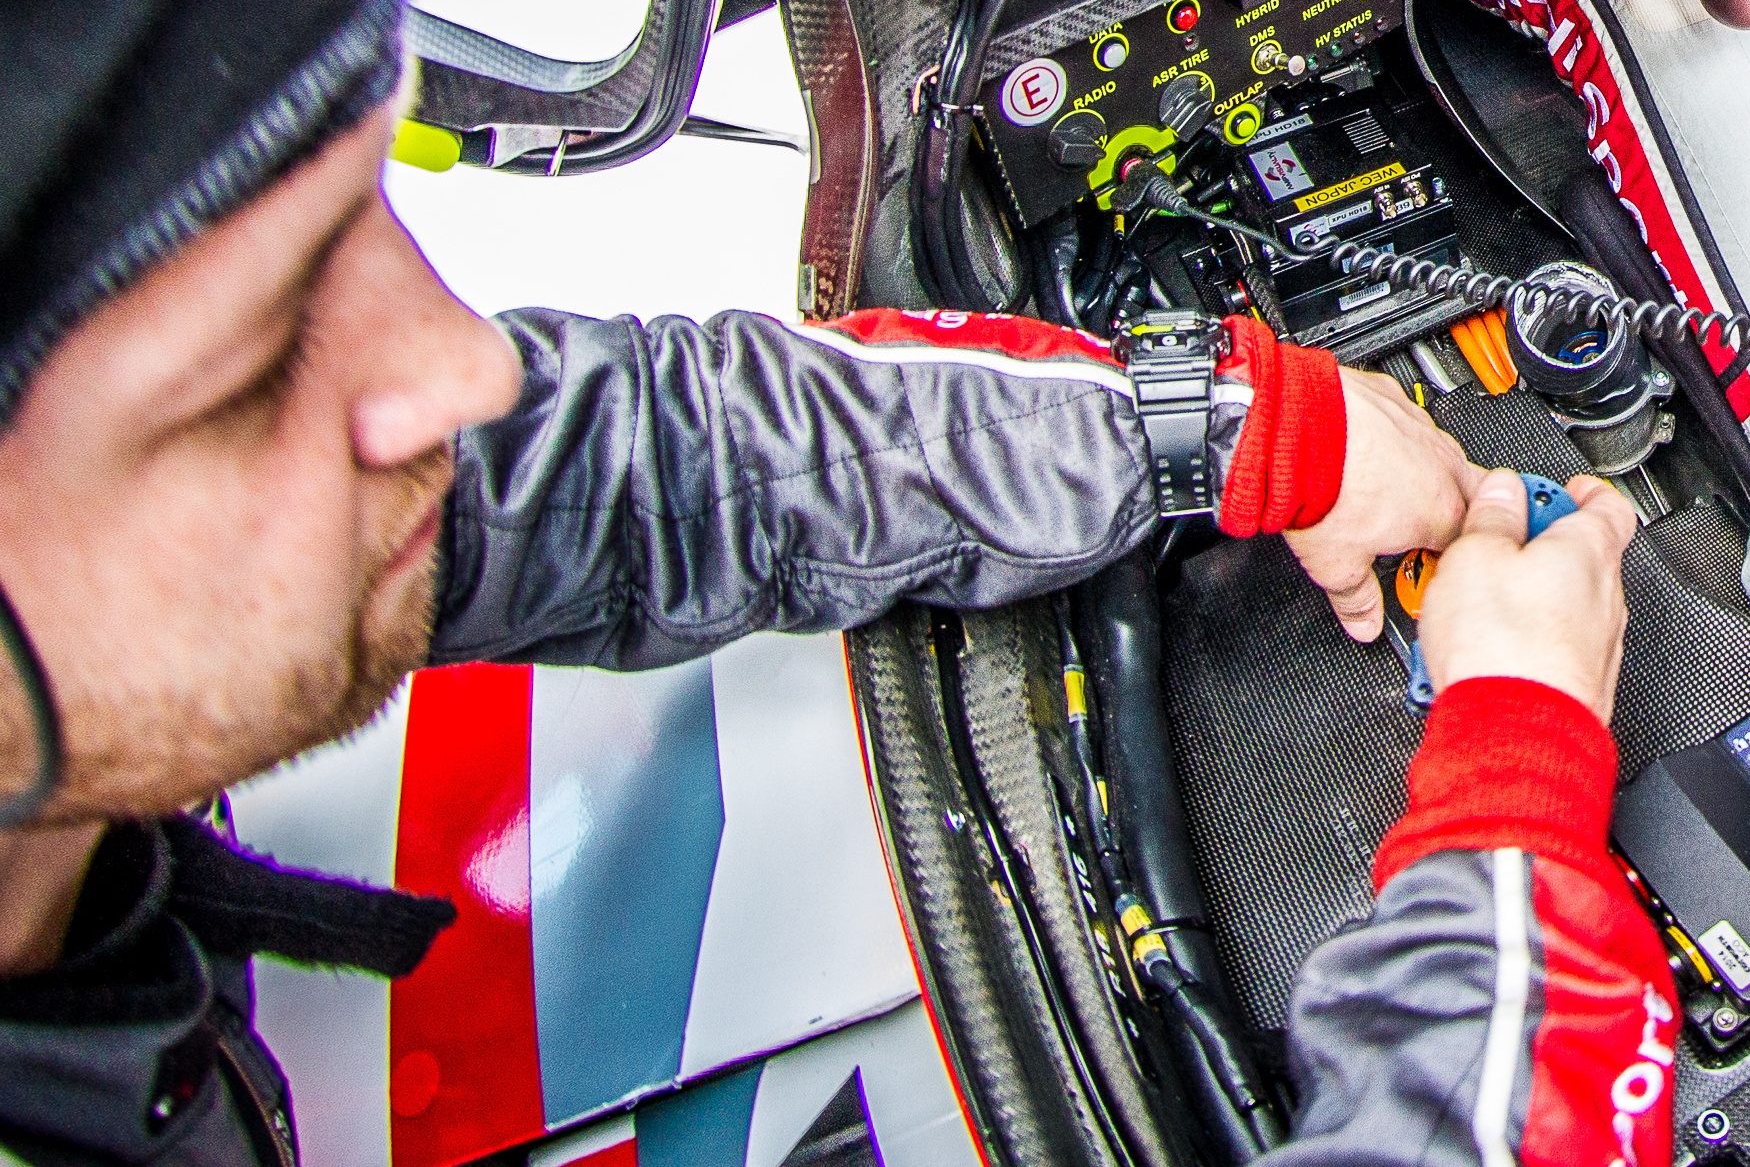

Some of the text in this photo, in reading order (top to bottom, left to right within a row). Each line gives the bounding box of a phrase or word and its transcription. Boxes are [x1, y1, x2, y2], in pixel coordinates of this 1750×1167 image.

[1089, 22, 1123, 44] DATA
[1249, 25, 1276, 47] DMS
[1315, 9, 1373, 48] HV STATUS
[1152, 48, 1210, 88] ASR TIRE
[1021, 73, 1048, 111] E
[1073, 80, 1117, 110] RADIO
[1214, 80, 1264, 116] OUTLAP
[1305, 166, 1399, 207] WEC JAPON
